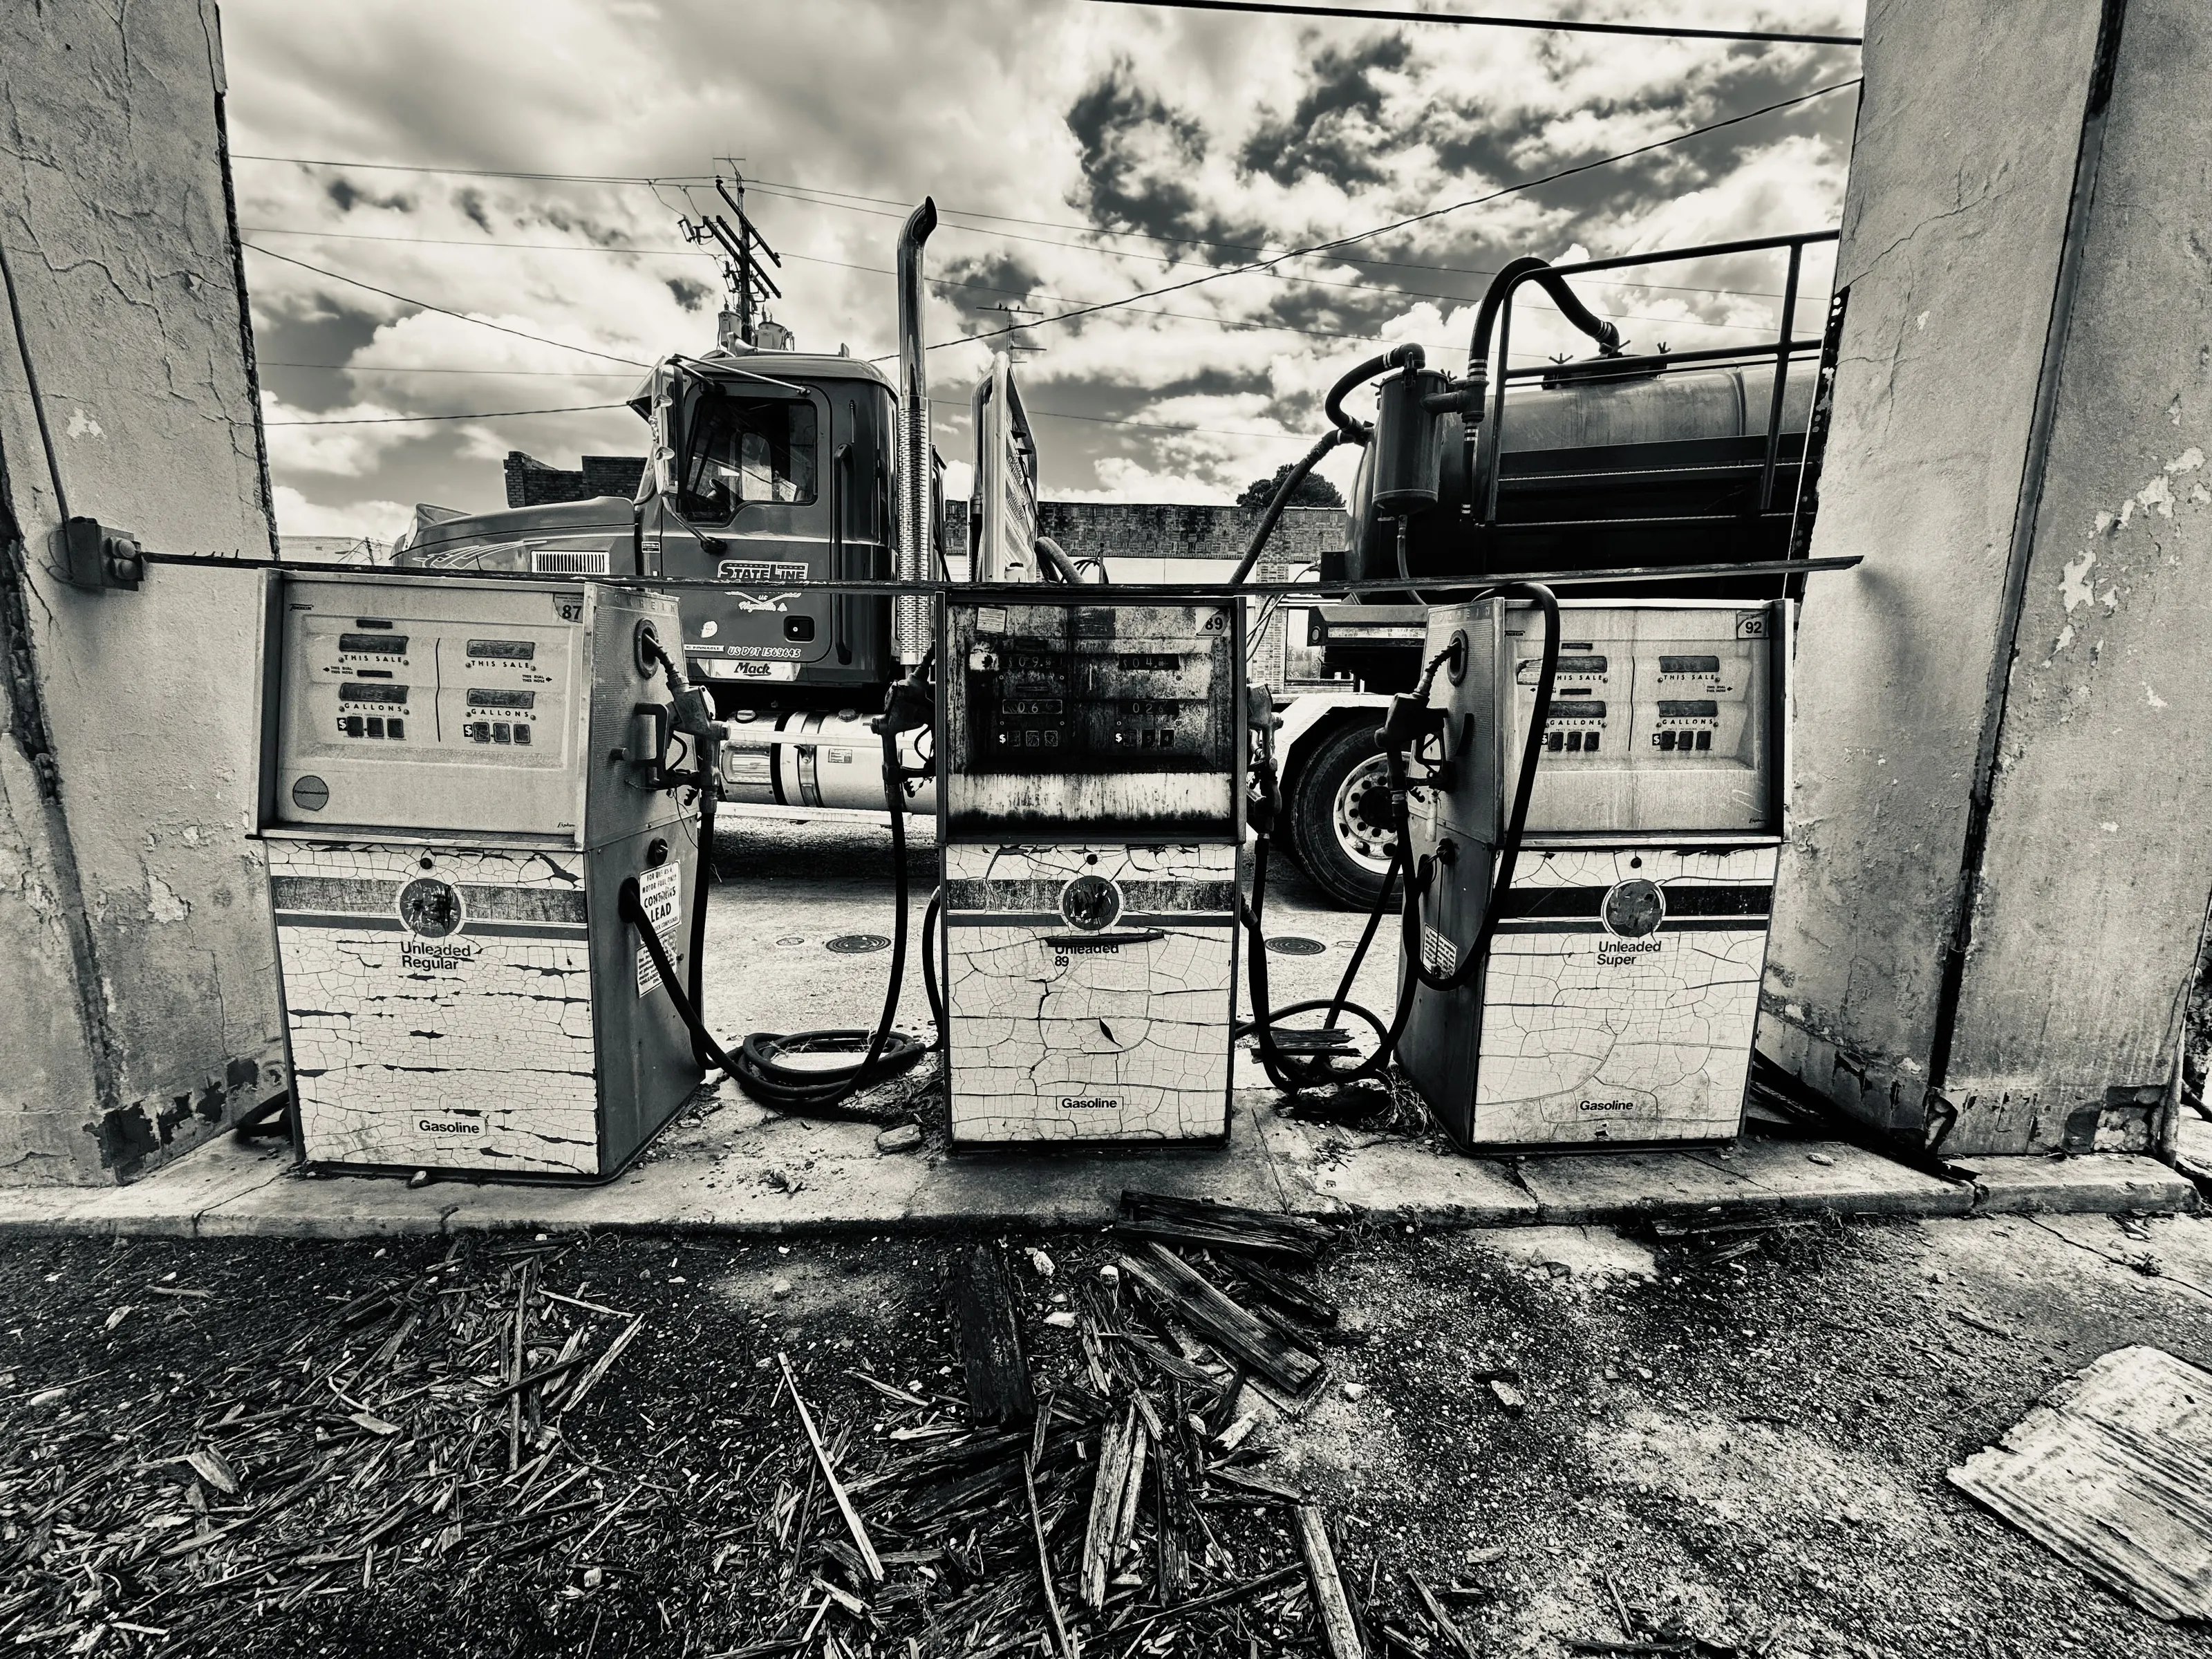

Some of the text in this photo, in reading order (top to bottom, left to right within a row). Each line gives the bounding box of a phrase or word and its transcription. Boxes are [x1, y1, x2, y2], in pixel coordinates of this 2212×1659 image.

[562, 605, 582, 620] 87
[1205, 617, 1223, 630] 89
[1745, 621, 1762, 634] 92
[728, 646, 801, 657] US DOT 1569645
[734, 662, 771, 676] Mack
[344, 702, 402, 712] GALLONS
[471, 709, 529, 718] GALLONS
[339, 719, 346, 729] $
[465, 725, 473, 735] $
[999, 733, 1006, 744] $
[1115, 733, 1123, 743] $
[1541, 734, 1548, 744] $
[1653, 735, 1660, 744] $
[642, 882, 657, 894] MOTOR
[650, 902, 672, 923] LEAD
[400, 941, 471, 958] Unleaded
[1055, 945, 1119, 955] Unleaded
[1598, 940, 1662, 953] Unleaded
[402, 955, 459, 971] Regular
[1054, 956, 1069, 967] 89
[1597, 953, 1637, 967] Super
[1061, 1098, 1117, 1109] Gasoline
[1580, 1099, 1633, 1111] Gasoline
[419, 1120, 480, 1134] Gasoline
